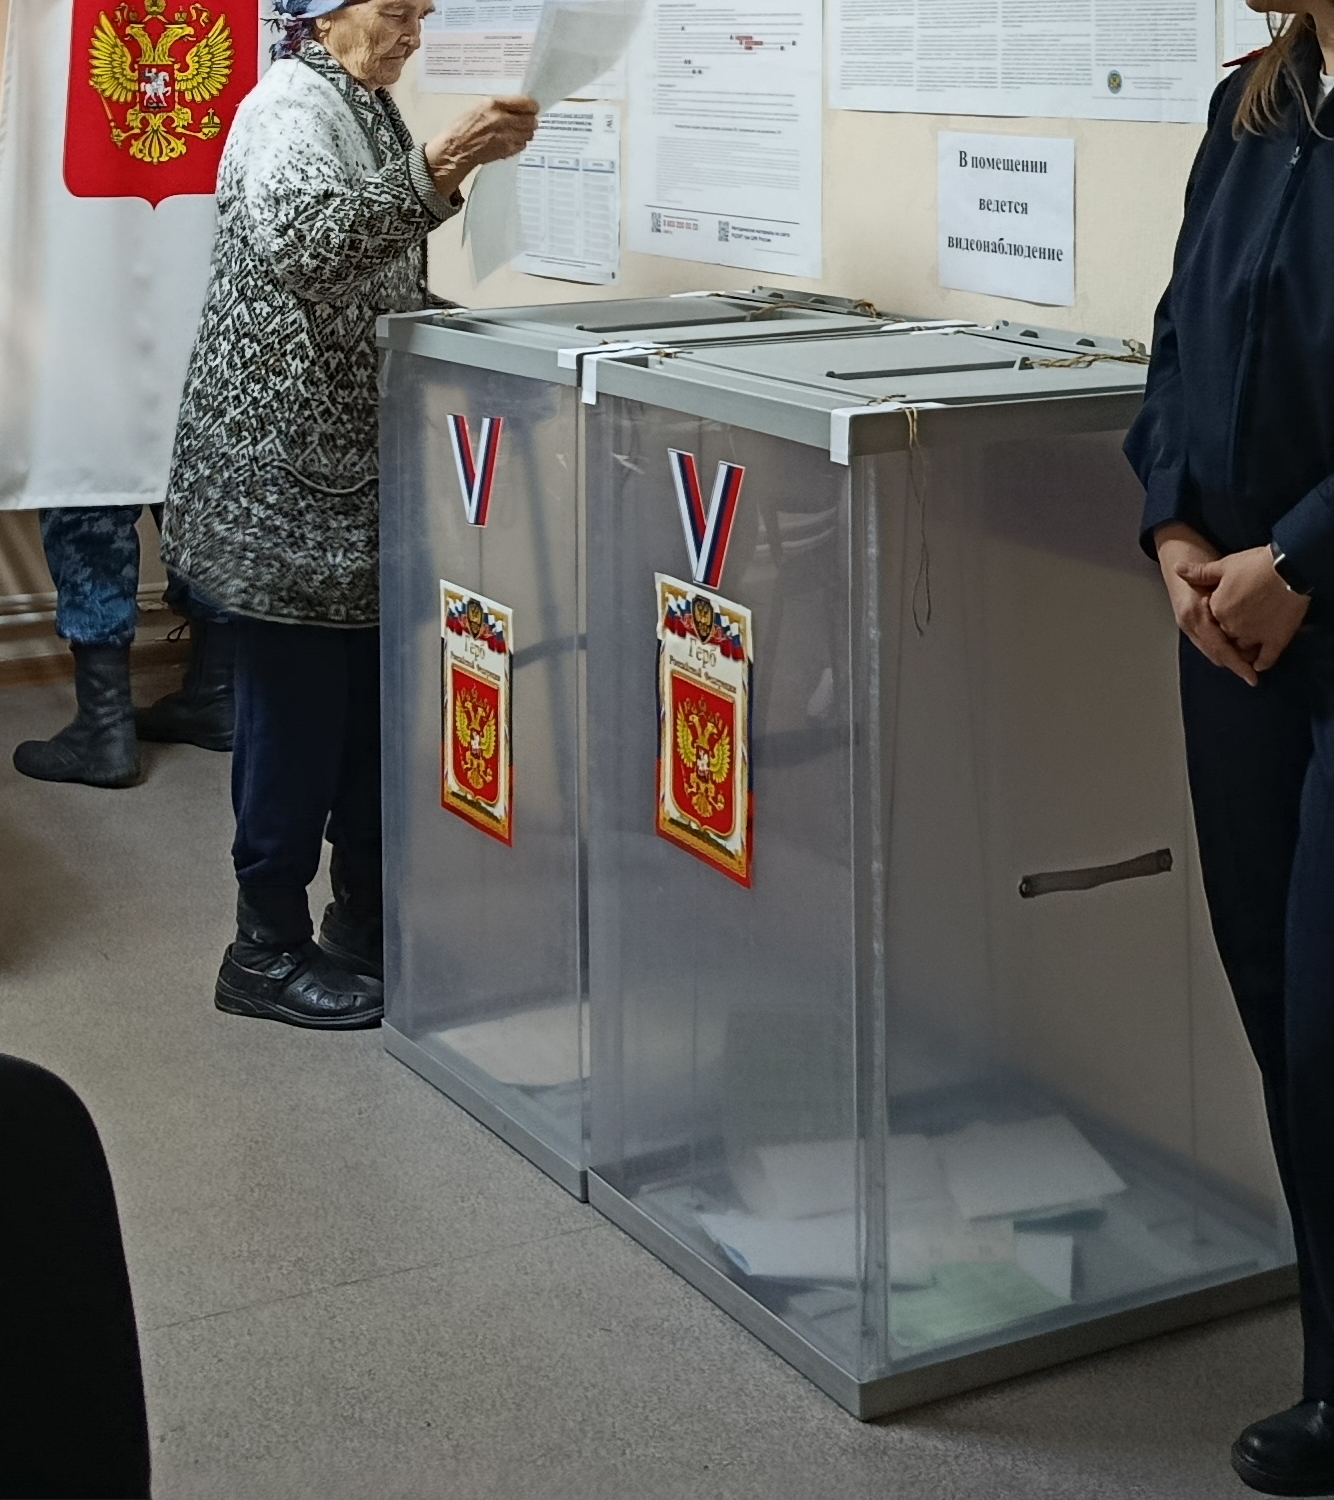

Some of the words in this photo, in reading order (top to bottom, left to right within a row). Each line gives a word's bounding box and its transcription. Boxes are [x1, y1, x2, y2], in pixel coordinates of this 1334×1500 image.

[959, 150, 968, 168] В
[971, 156, 1047, 174] помещении
[978, 198, 1028, 215] ведется
[947, 235, 1063, 262] видеонаблюдение
[688, 638, 717, 668] Герб
